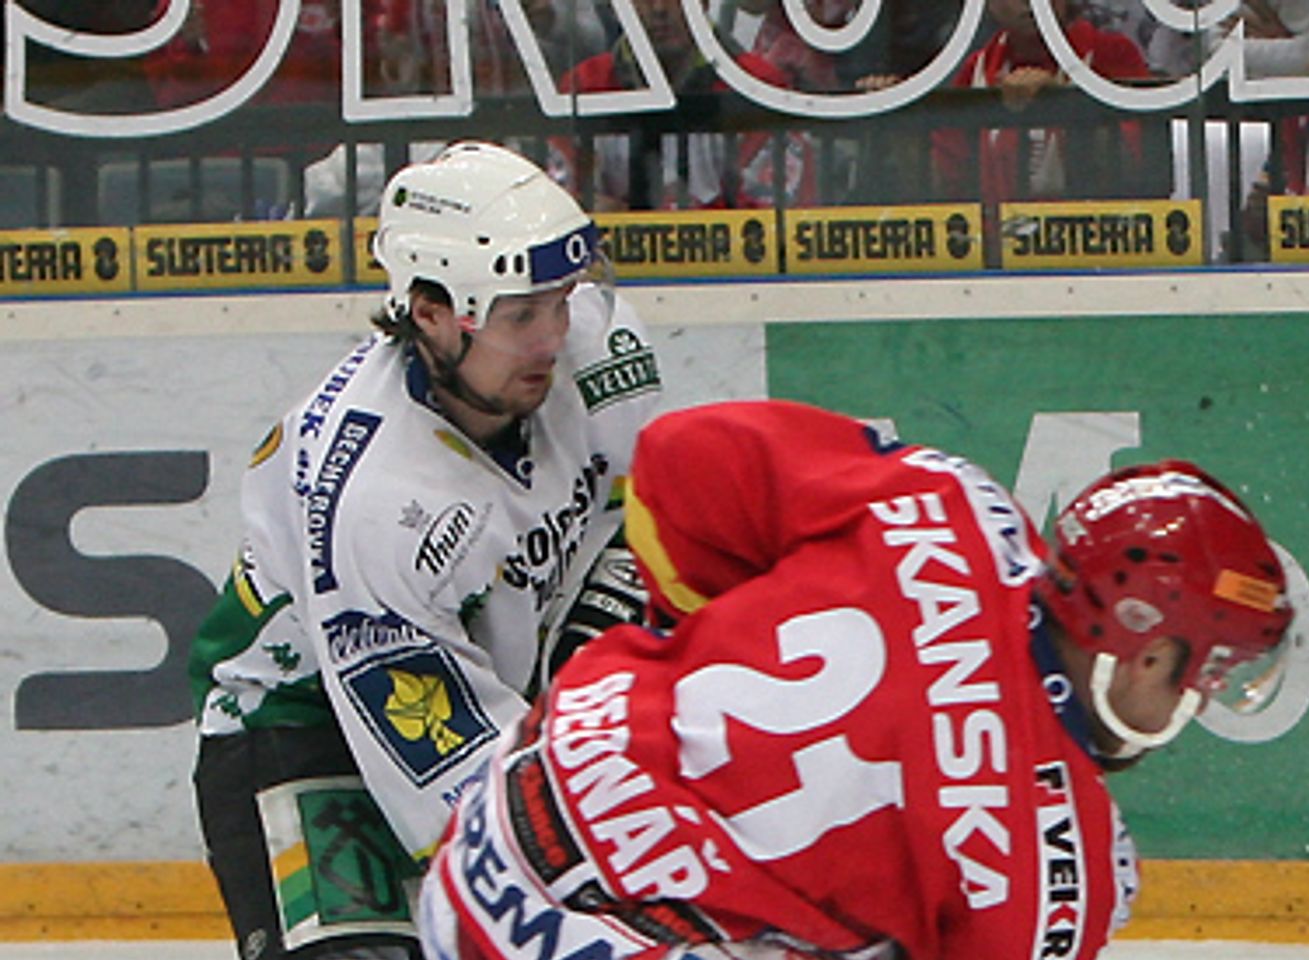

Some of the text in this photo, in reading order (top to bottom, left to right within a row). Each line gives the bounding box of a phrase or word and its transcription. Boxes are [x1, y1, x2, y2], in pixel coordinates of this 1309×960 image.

[147, 234, 293, 277] SUBTERRA
[796, 218, 936, 260] SUBTERRA
[1012, 214, 1154, 256] SUBTERRA
[672, 607, 905, 862] 21
[868, 492, 1011, 911] SKANSKA
[552, 671, 731, 900] BEDNÁŘ
